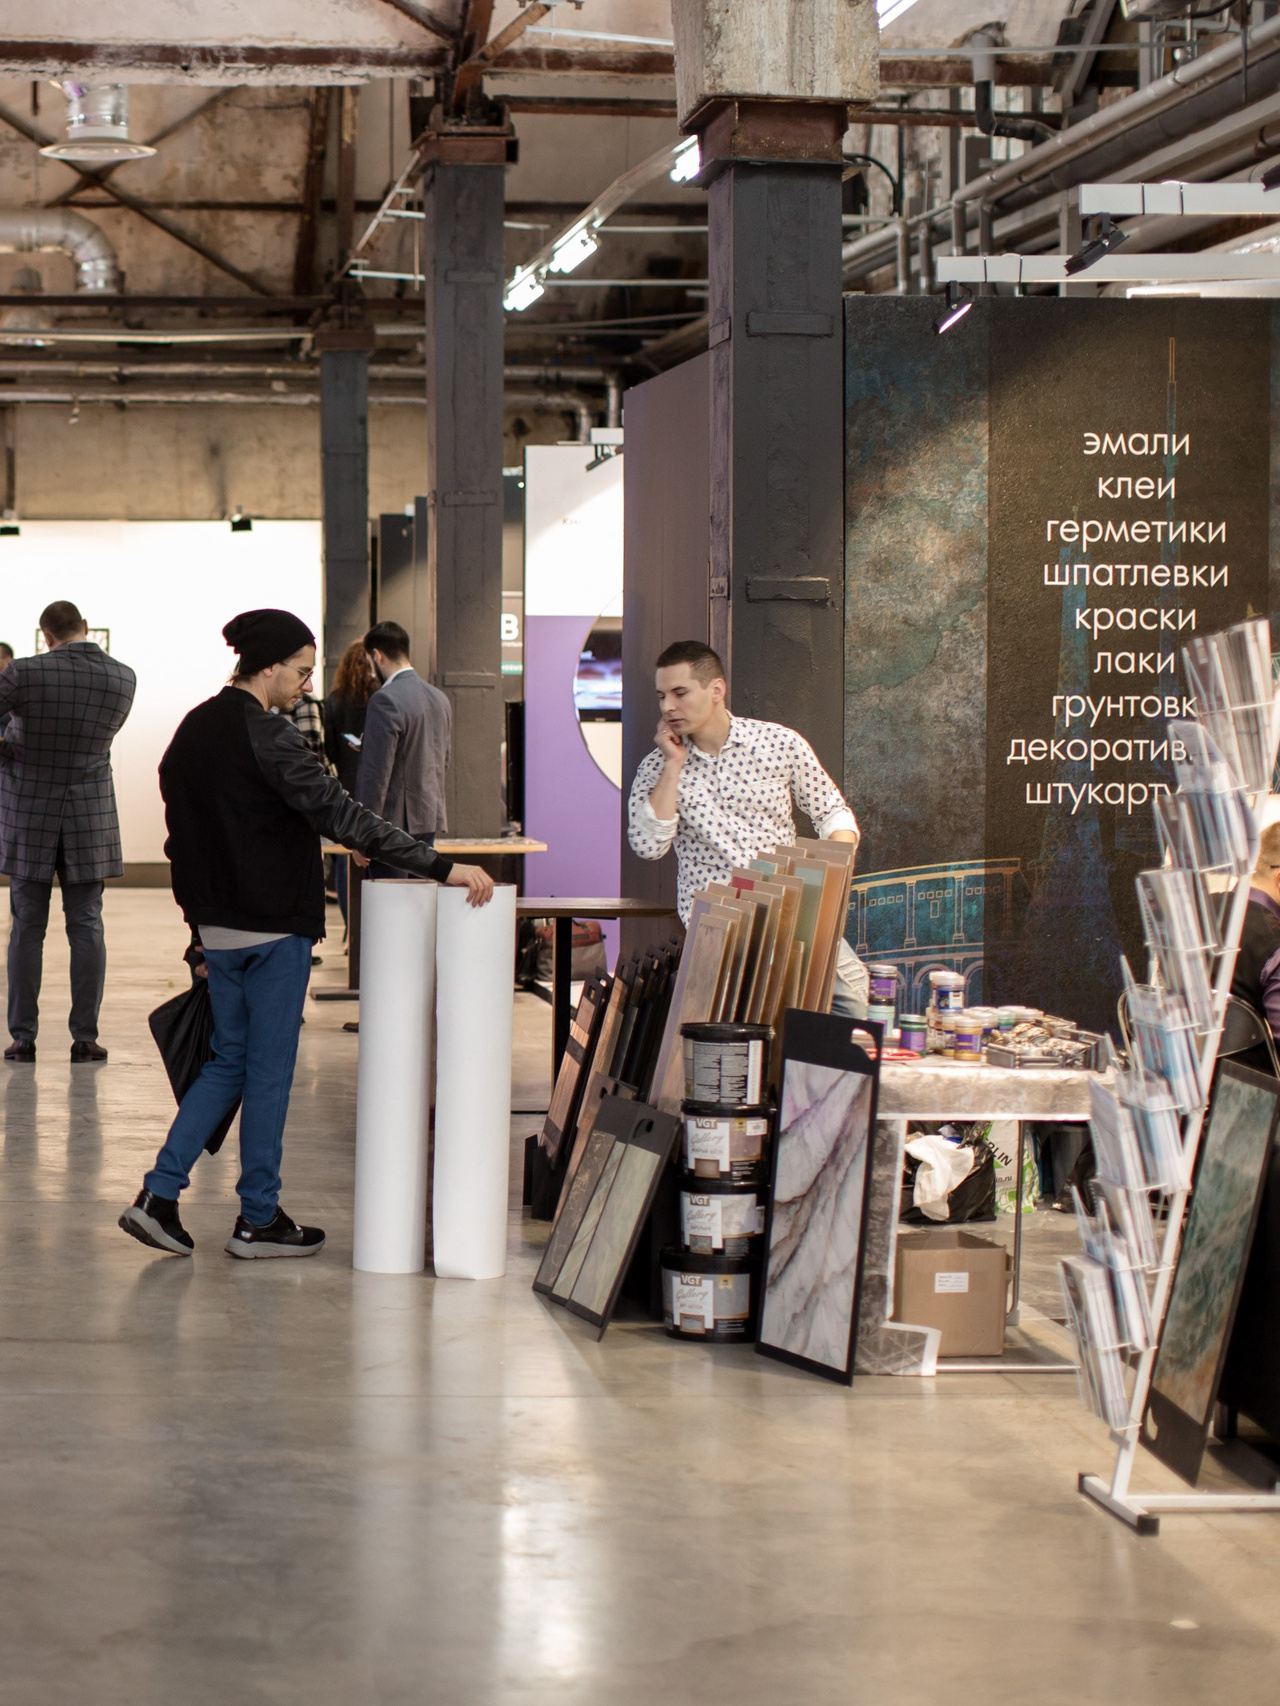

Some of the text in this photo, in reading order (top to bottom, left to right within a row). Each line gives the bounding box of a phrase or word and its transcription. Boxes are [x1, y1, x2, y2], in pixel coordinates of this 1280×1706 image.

[1083, 432, 1190, 456] эмали
[1098, 475, 1176, 500] клеи
[1046, 518, 1227, 552] герметики
[1043, 563, 1229, 588] шпатлевки
[1075, 607, 1197, 640] краски
[1093, 650, 1176, 674] лаки
[1052, 695, 1198, 727] грунтовк
[1007, 739, 1193, 770] декоратив
[696, 1118, 716, 1128] VGT
[690, 1195, 709, 1205] VGT
[681, 1274, 701, 1285] VGT
